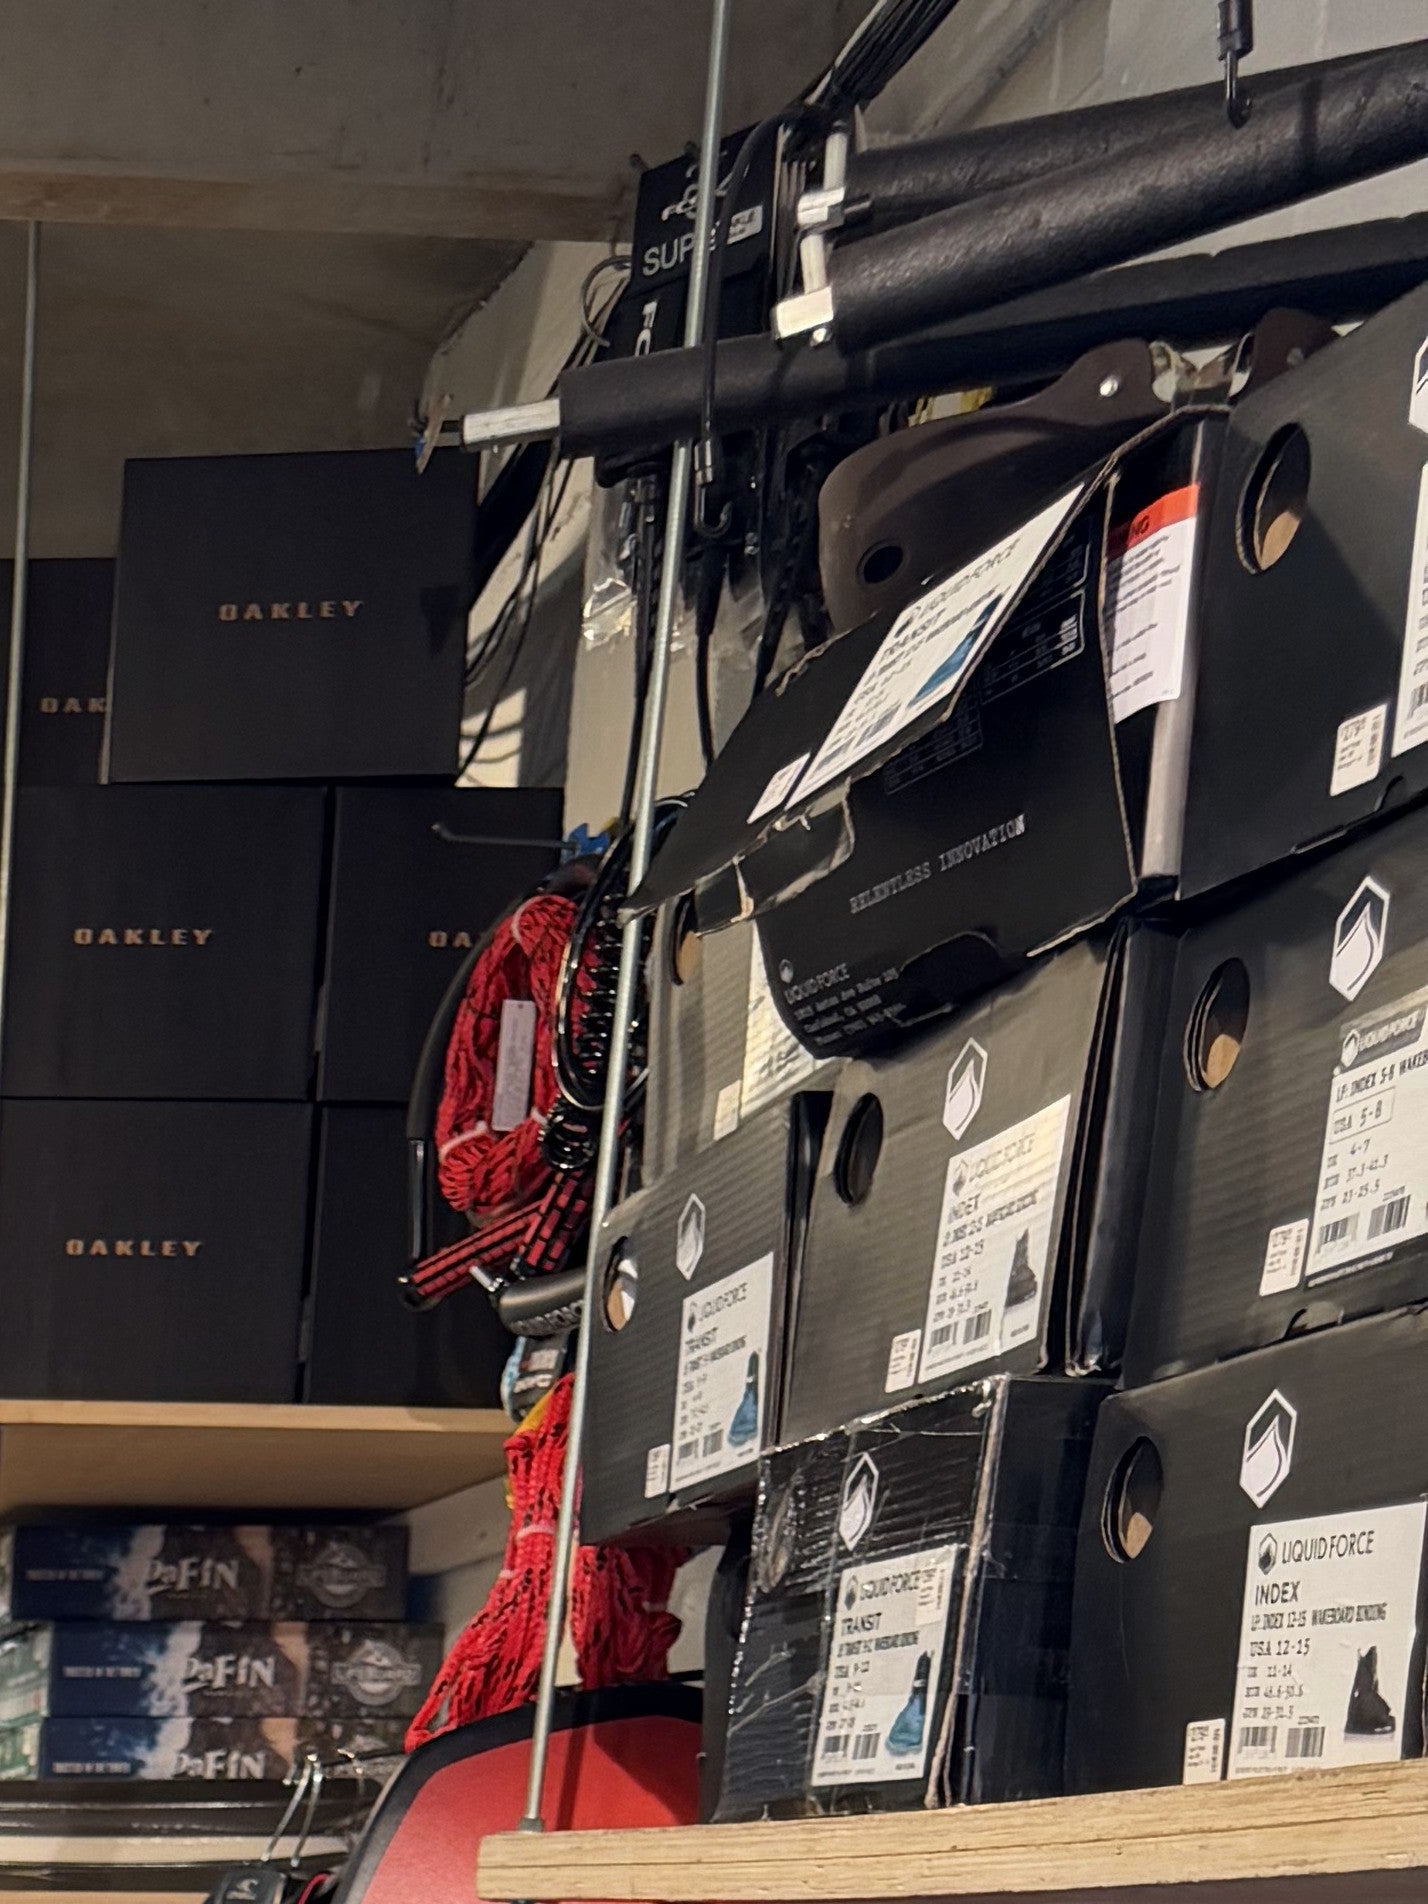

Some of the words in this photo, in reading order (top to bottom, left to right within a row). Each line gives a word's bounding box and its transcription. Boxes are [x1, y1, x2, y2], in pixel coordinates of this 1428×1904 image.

[219, 600, 364, 623] OAKLEY
[40, 696, 108, 714] OAK
[849, 861, 932, 914] RELENTLESS
[939, 813, 1025, 872] INNOVATION
[74, 928, 213, 946] OAKLEY
[66, 1239, 202, 1257] OAKLEY
[1255, 1581, 1301, 1605] INDEX
[1250, 1641, 1271, 1656] USA
